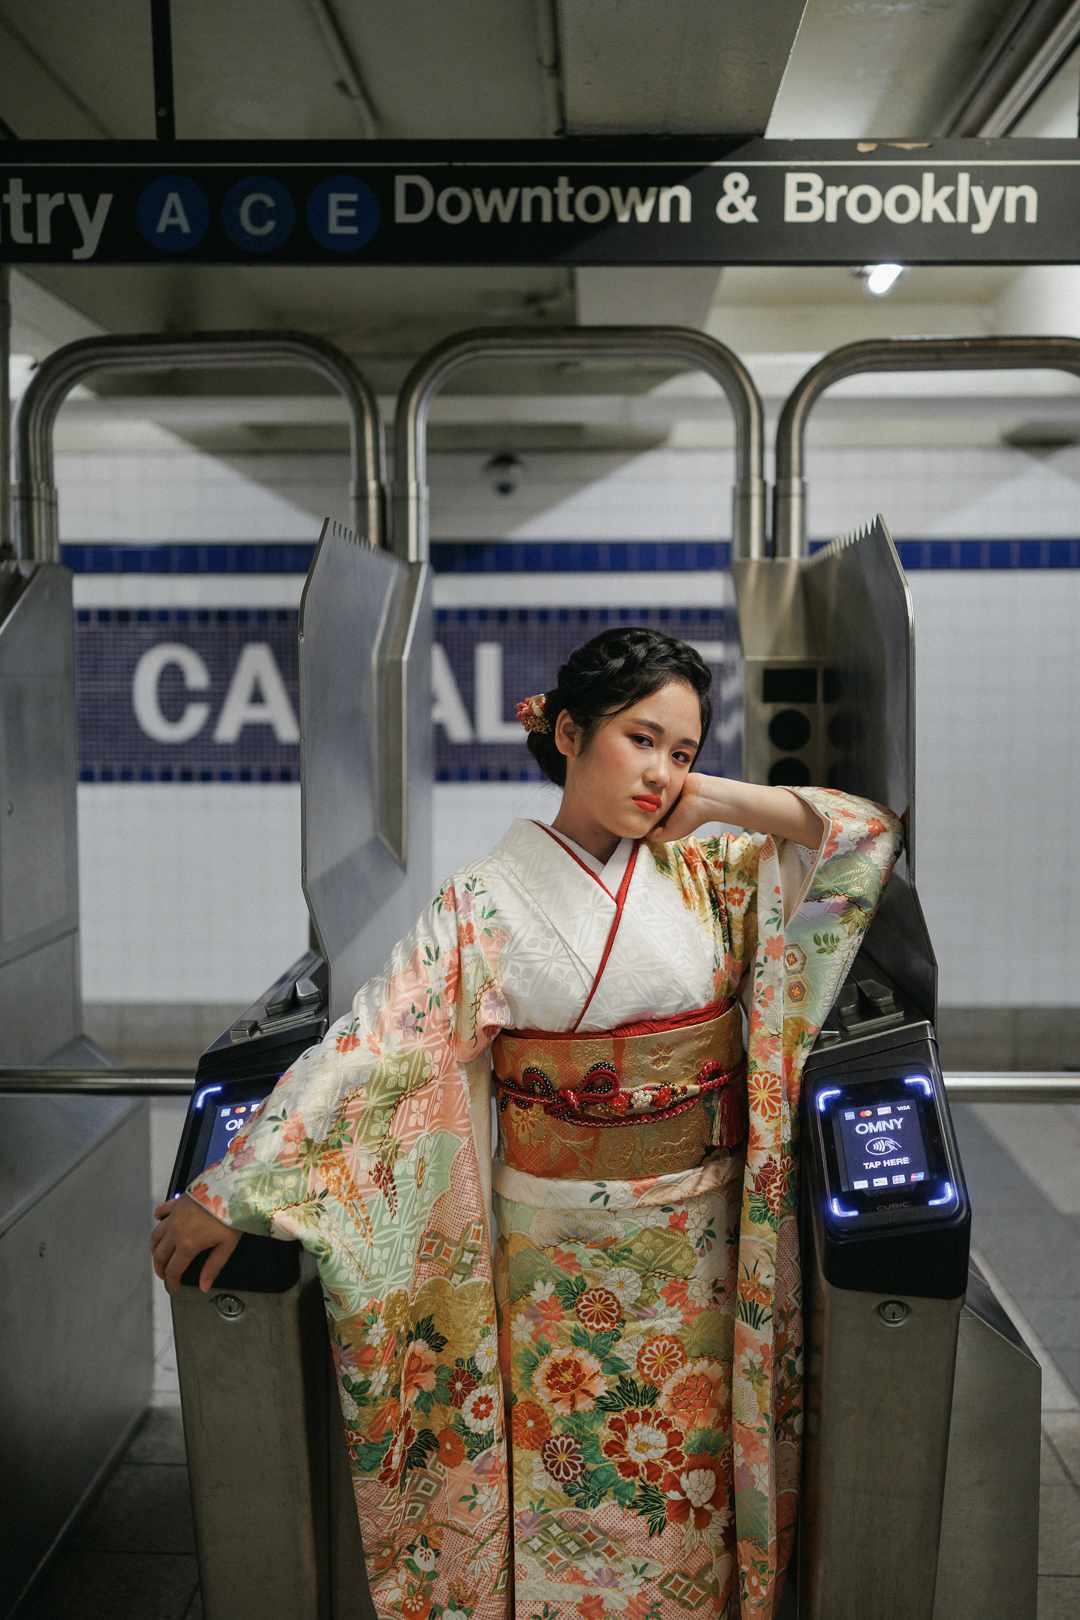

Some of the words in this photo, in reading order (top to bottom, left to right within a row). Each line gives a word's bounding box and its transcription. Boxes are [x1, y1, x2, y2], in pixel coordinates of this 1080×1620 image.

[0, 178, 113, 259] try
[155, 192, 191, 233] A
[240, 193, 276, 235] C
[328, 193, 359, 234] E
[394, 174, 692, 224] Downtown
[715, 172, 759, 224] &
[783, 172, 1038, 234] Brooklyn
[855, 1118, 904, 1134] OMNY
[863, 1160, 881, 1170] TAP
[883, 1157, 909, 1168] HERE
[876, 1202, 909, 1211] CUBIC
